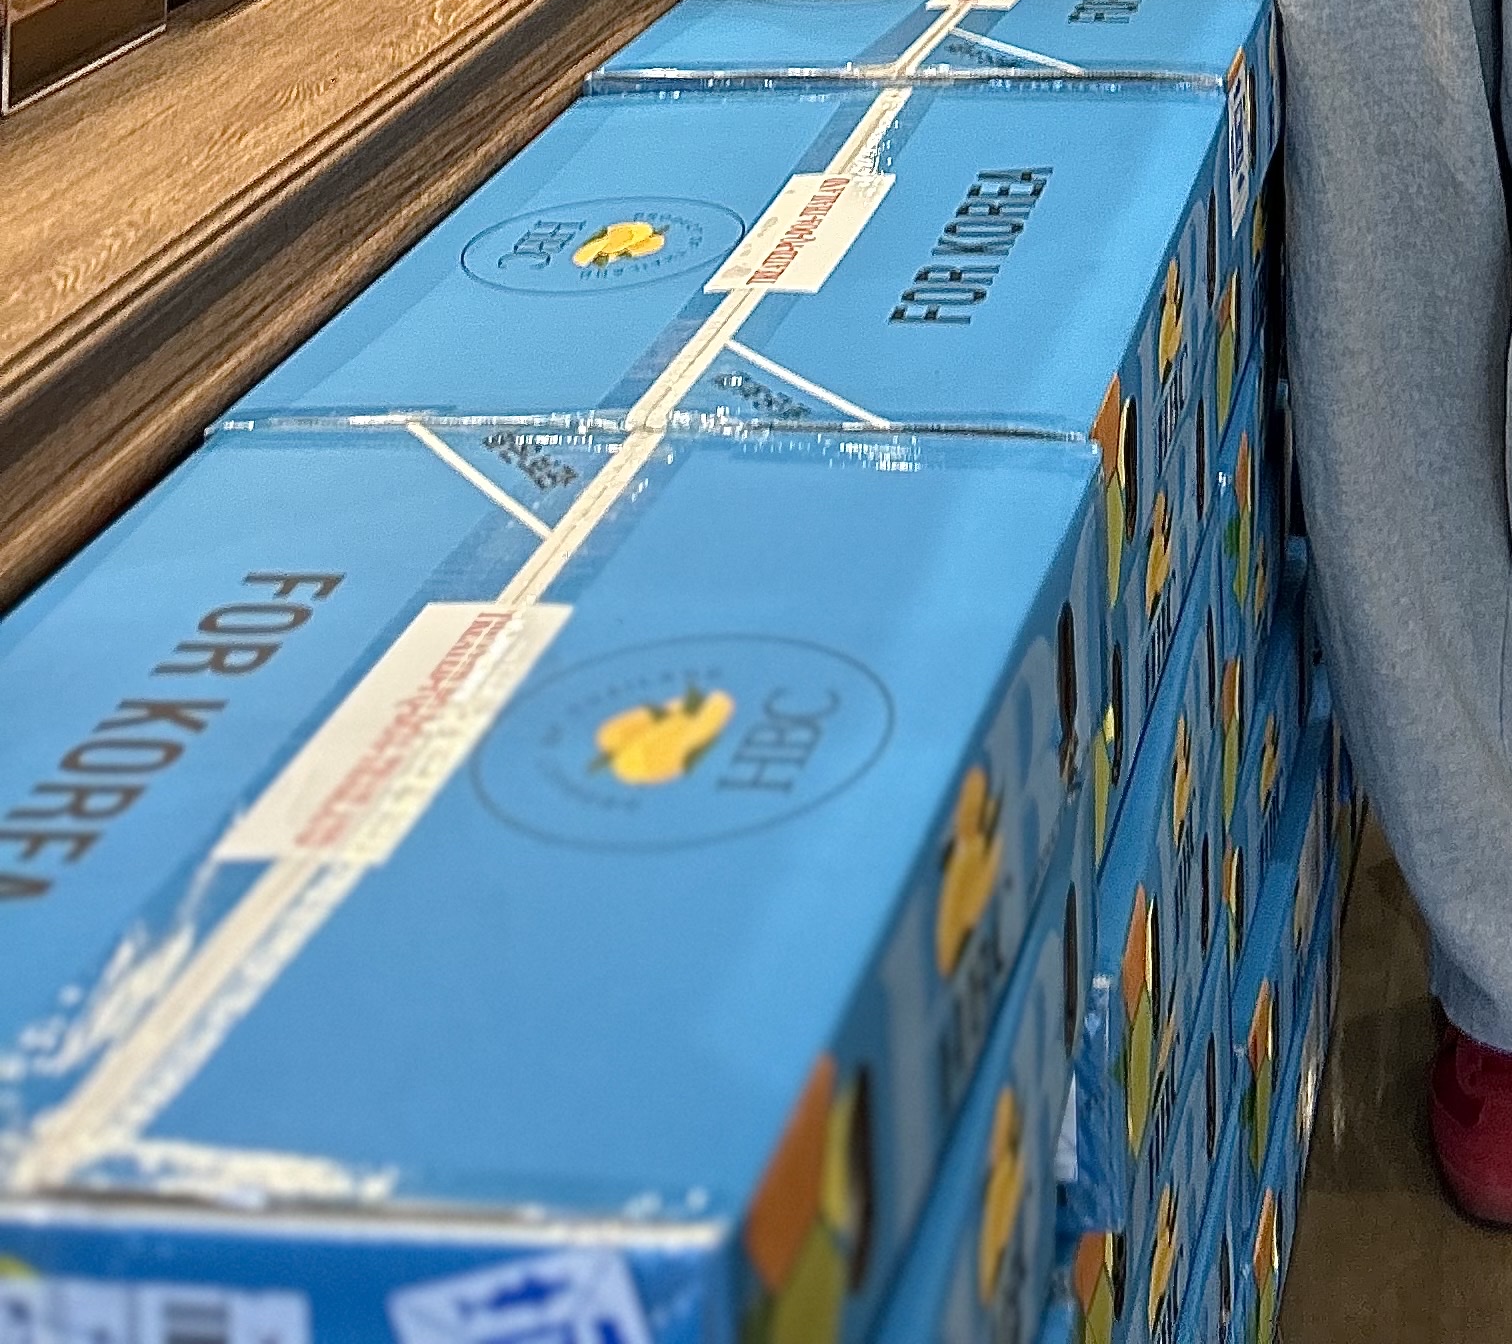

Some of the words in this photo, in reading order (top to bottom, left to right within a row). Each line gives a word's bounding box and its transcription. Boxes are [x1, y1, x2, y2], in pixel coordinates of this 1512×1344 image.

[497, 220, 587, 269] HBC
[931, 167, 1054, 256] KOREA
[888, 264, 1001, 325] FOR
[149, 572, 346, 677] FOR
[715, 686, 842, 794] HBC
